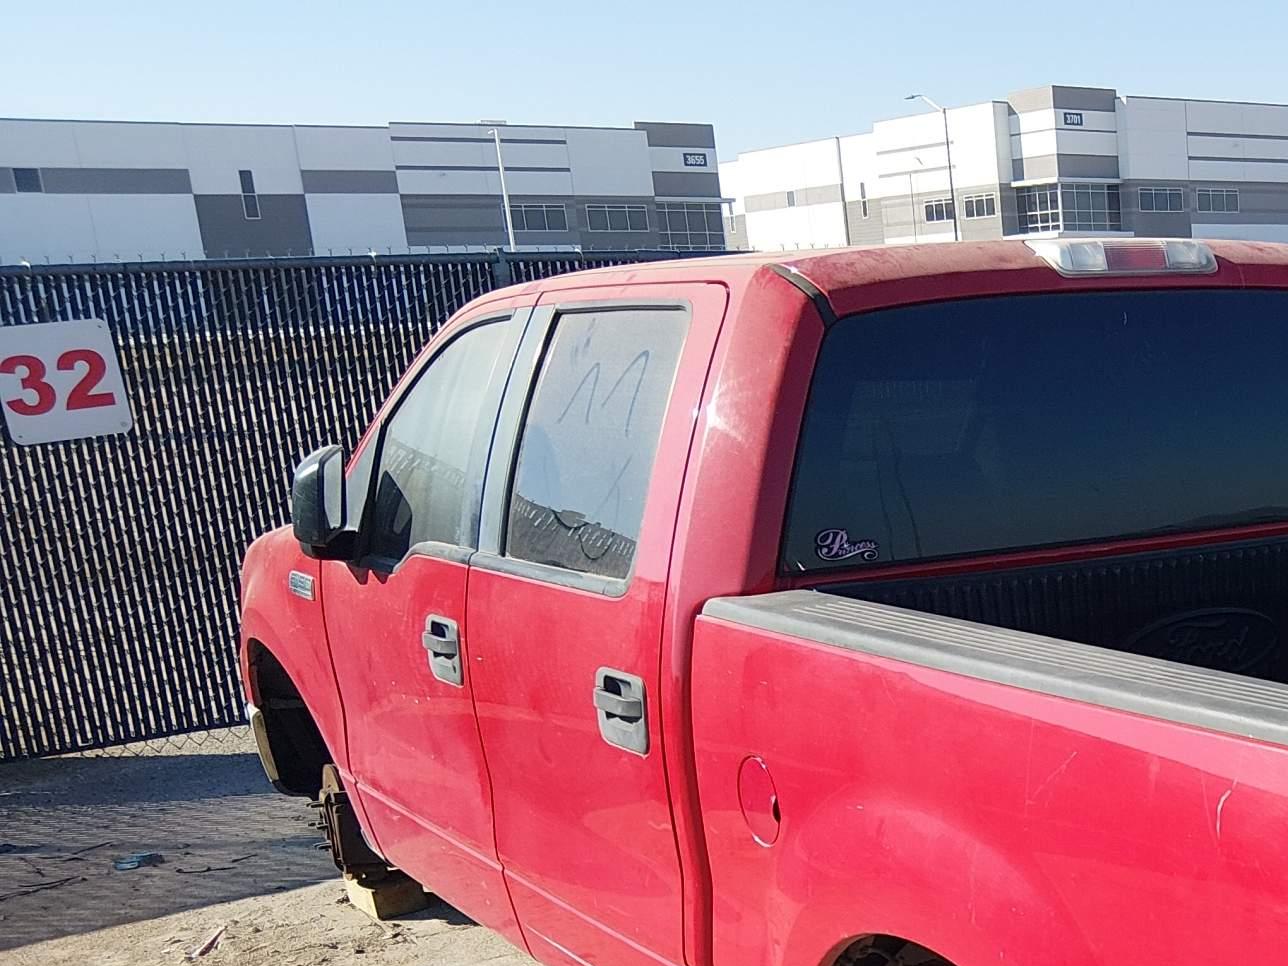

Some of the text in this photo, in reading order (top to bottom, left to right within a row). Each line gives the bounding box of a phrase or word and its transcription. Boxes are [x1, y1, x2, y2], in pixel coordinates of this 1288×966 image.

[1065, 113, 1081, 125] 3701
[685, 155, 705, 165] 3655
[0, 349, 116, 416] 32
[817, 528, 879, 560] Princess
